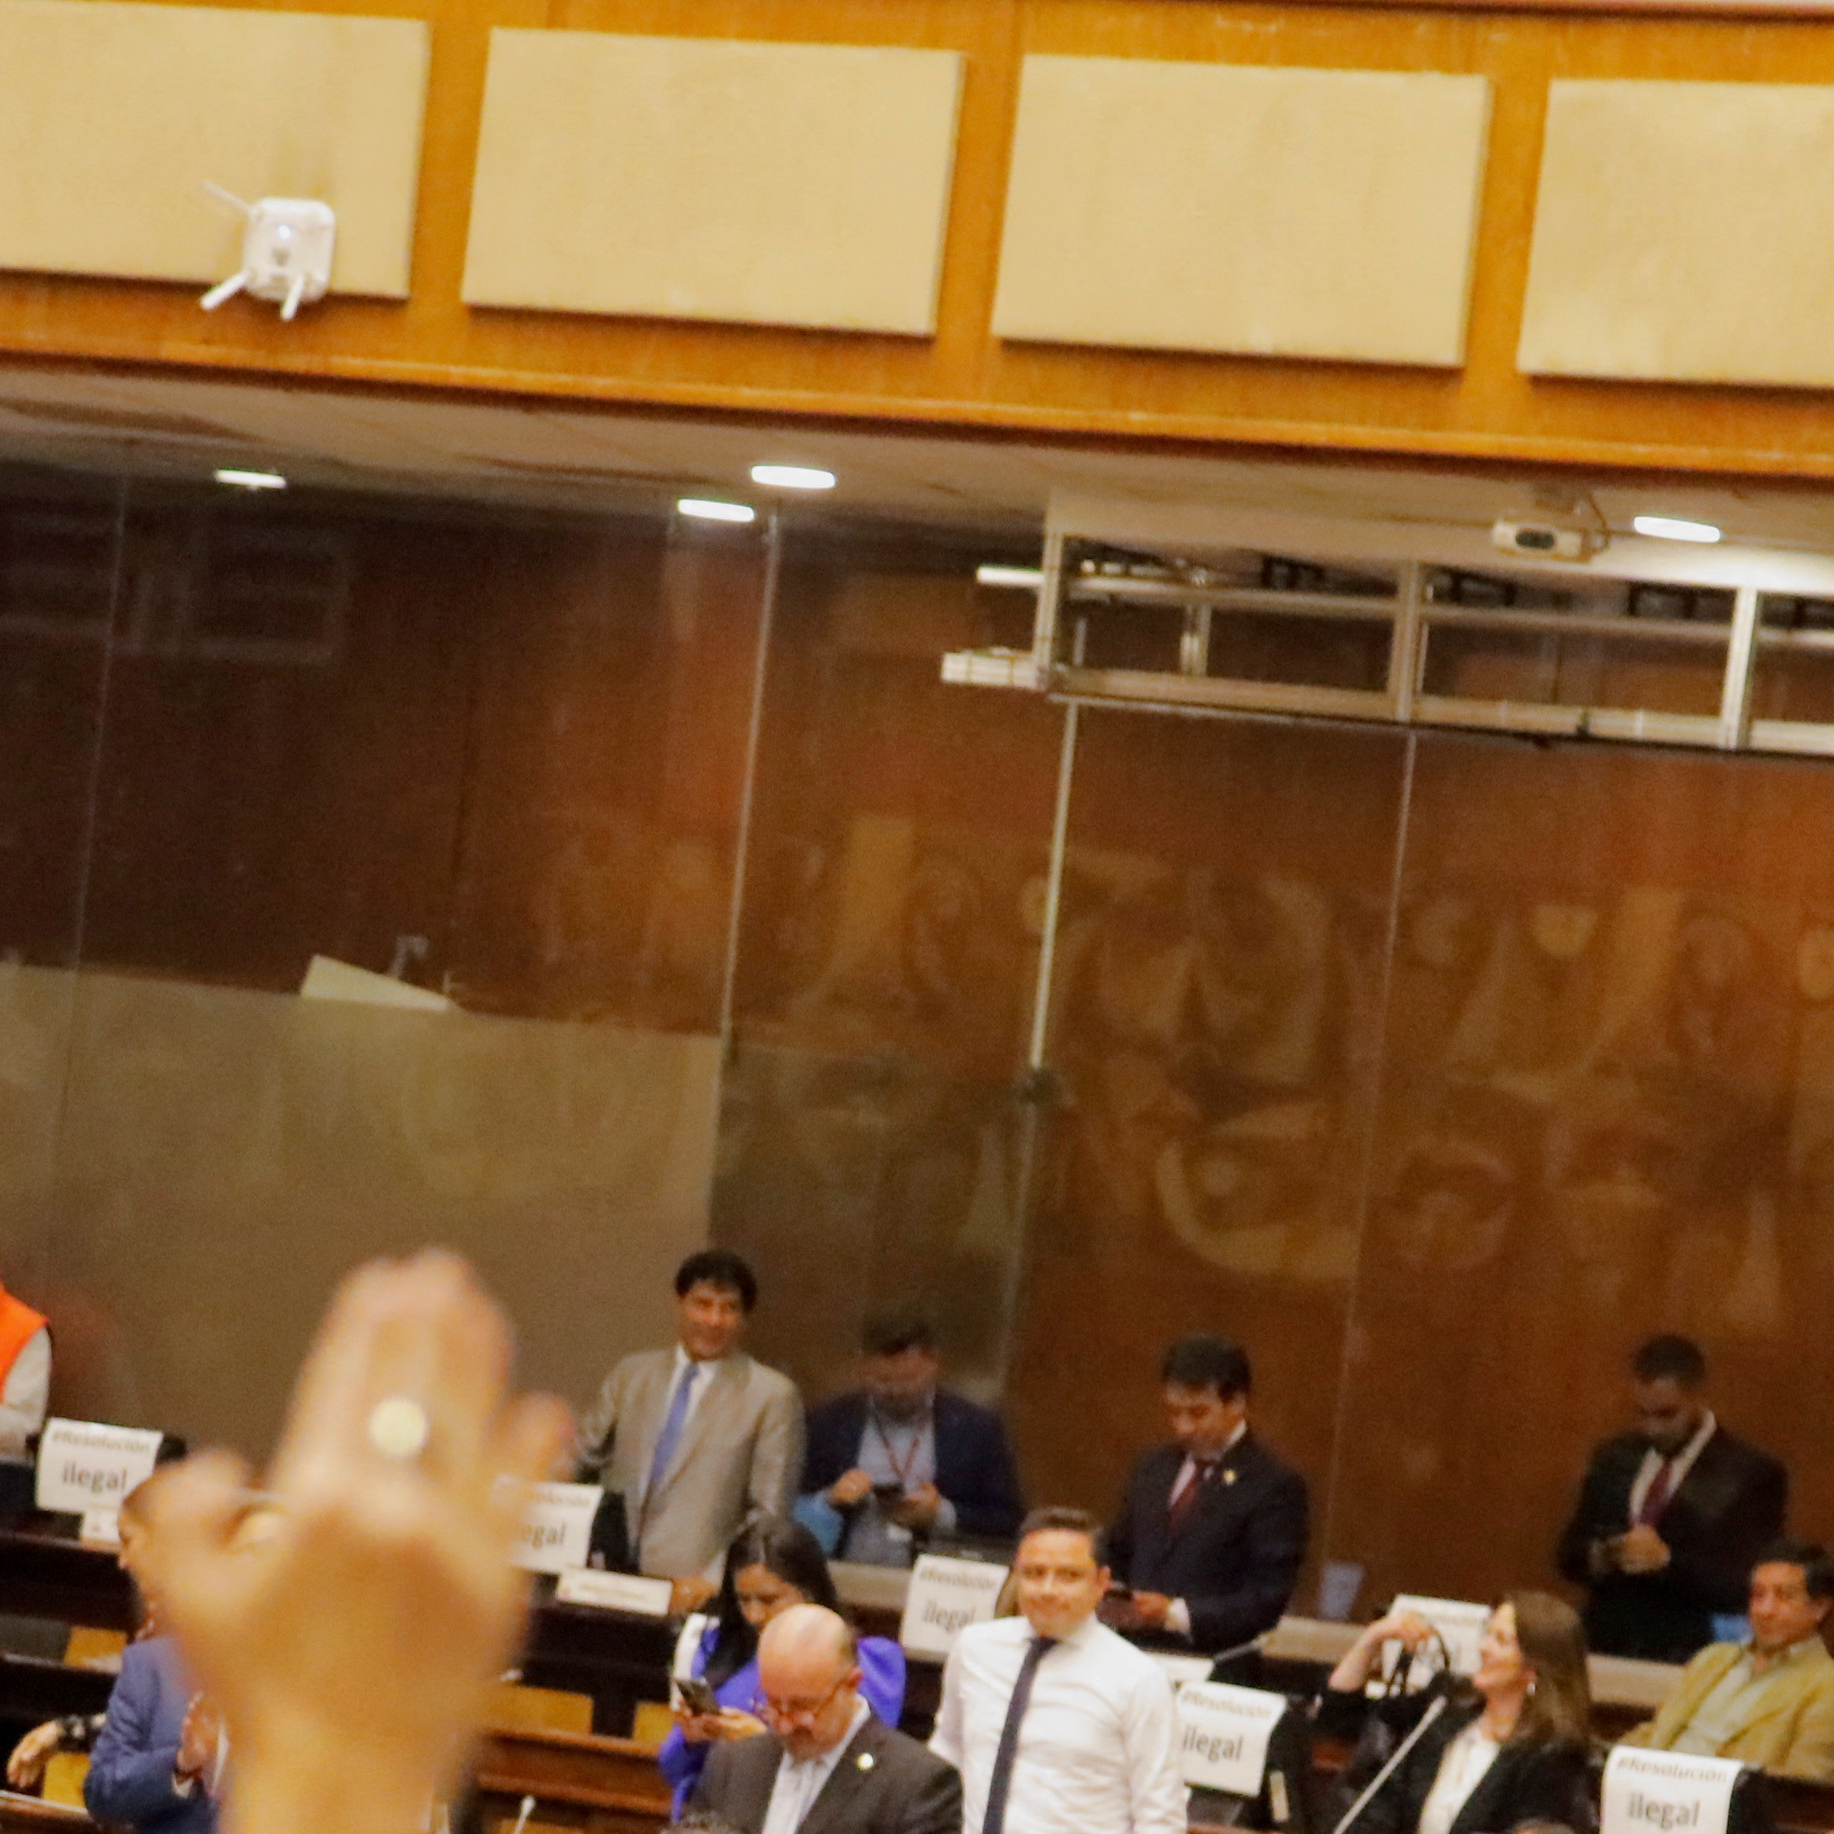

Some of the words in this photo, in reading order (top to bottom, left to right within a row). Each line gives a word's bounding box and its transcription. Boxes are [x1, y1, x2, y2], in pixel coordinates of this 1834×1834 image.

[63, 1464, 127, 1494] ilegal
[522, 1521, 567, 1547] egal
[923, 1600, 976, 1633] ilegal
[1183, 1724, 1242, 1762] ilegal
[1628, 1792, 1701, 1830] ilegal
